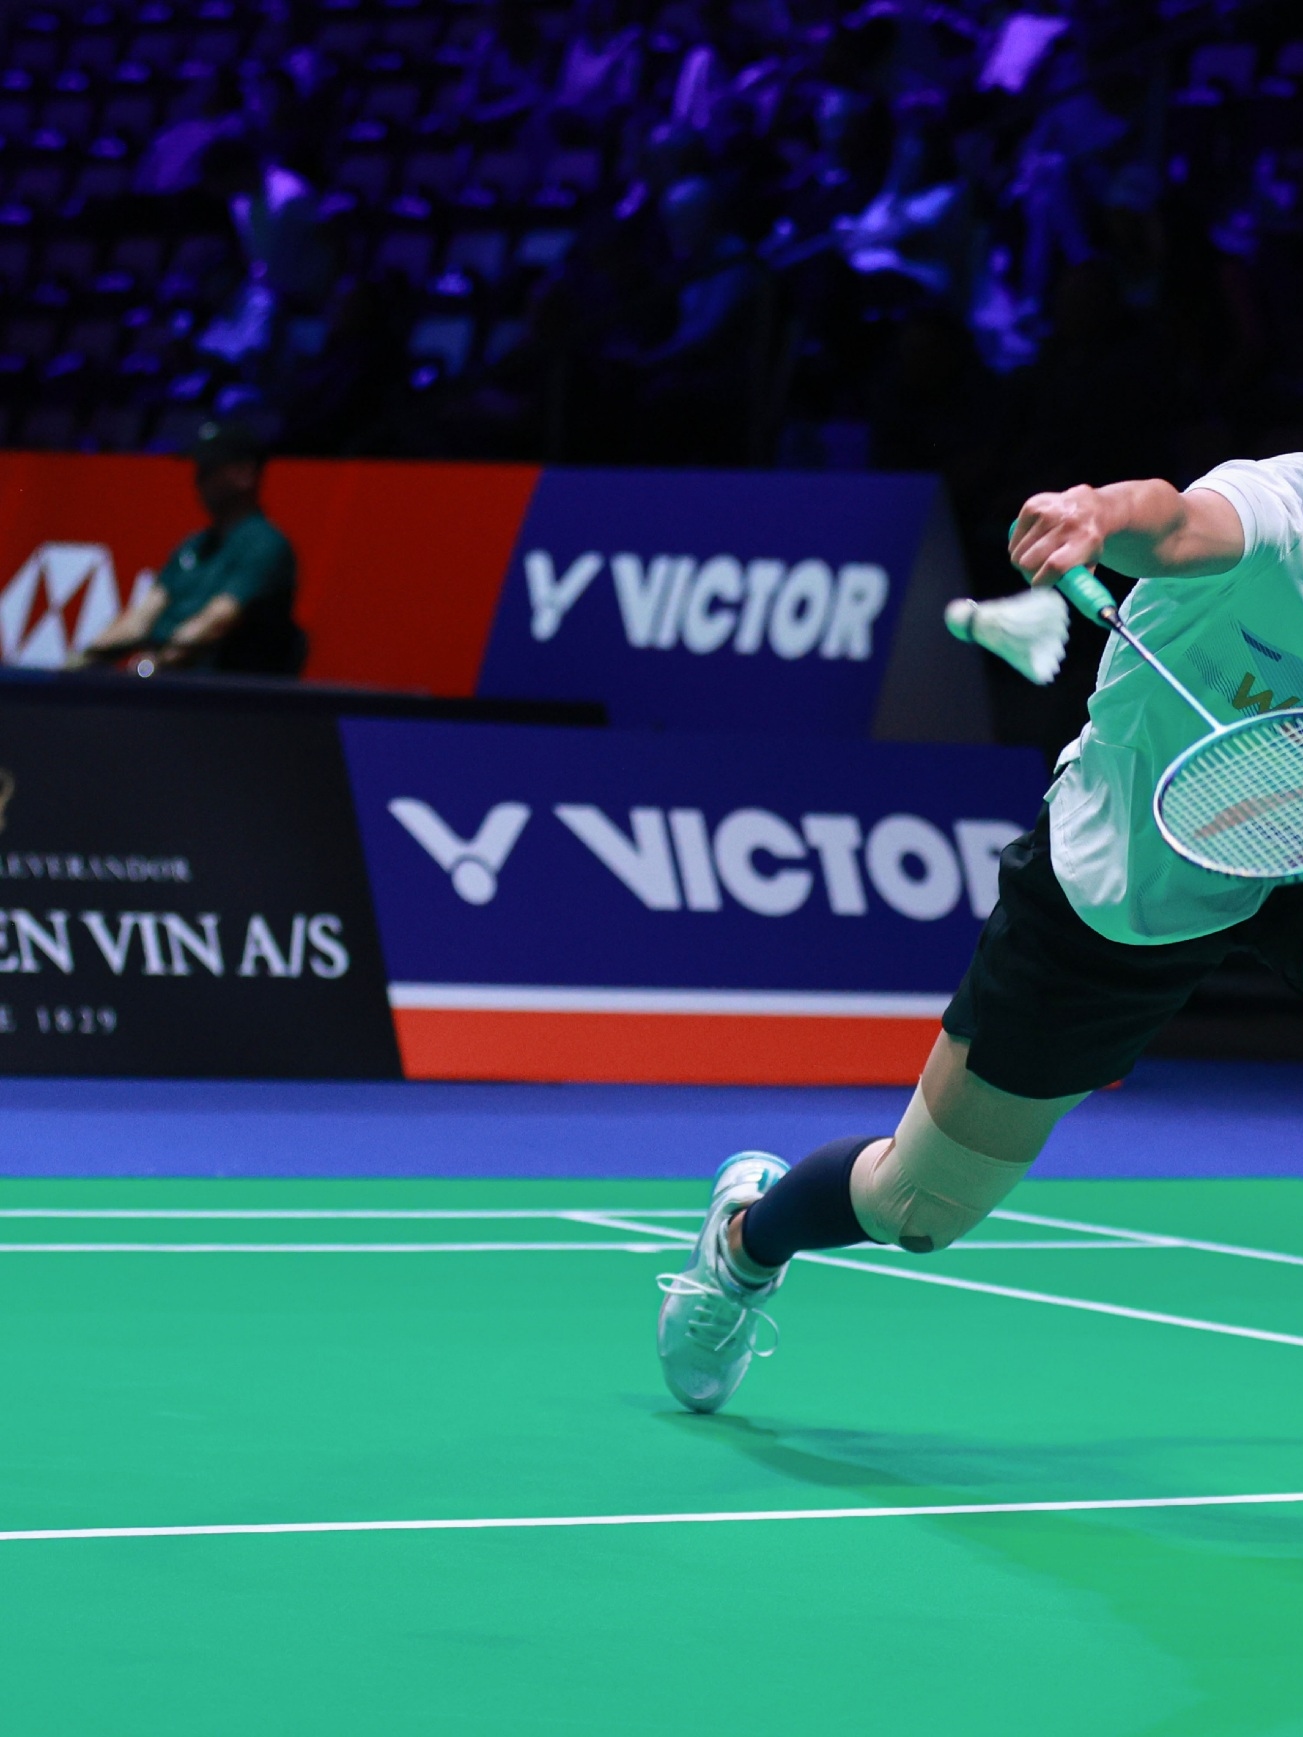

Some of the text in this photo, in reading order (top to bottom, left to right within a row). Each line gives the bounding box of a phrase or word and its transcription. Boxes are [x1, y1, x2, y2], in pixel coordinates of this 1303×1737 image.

[611, 552, 889, 661] VICTOR
[79, 909, 225, 977] VIN
[237, 911, 350, 979] A/S
